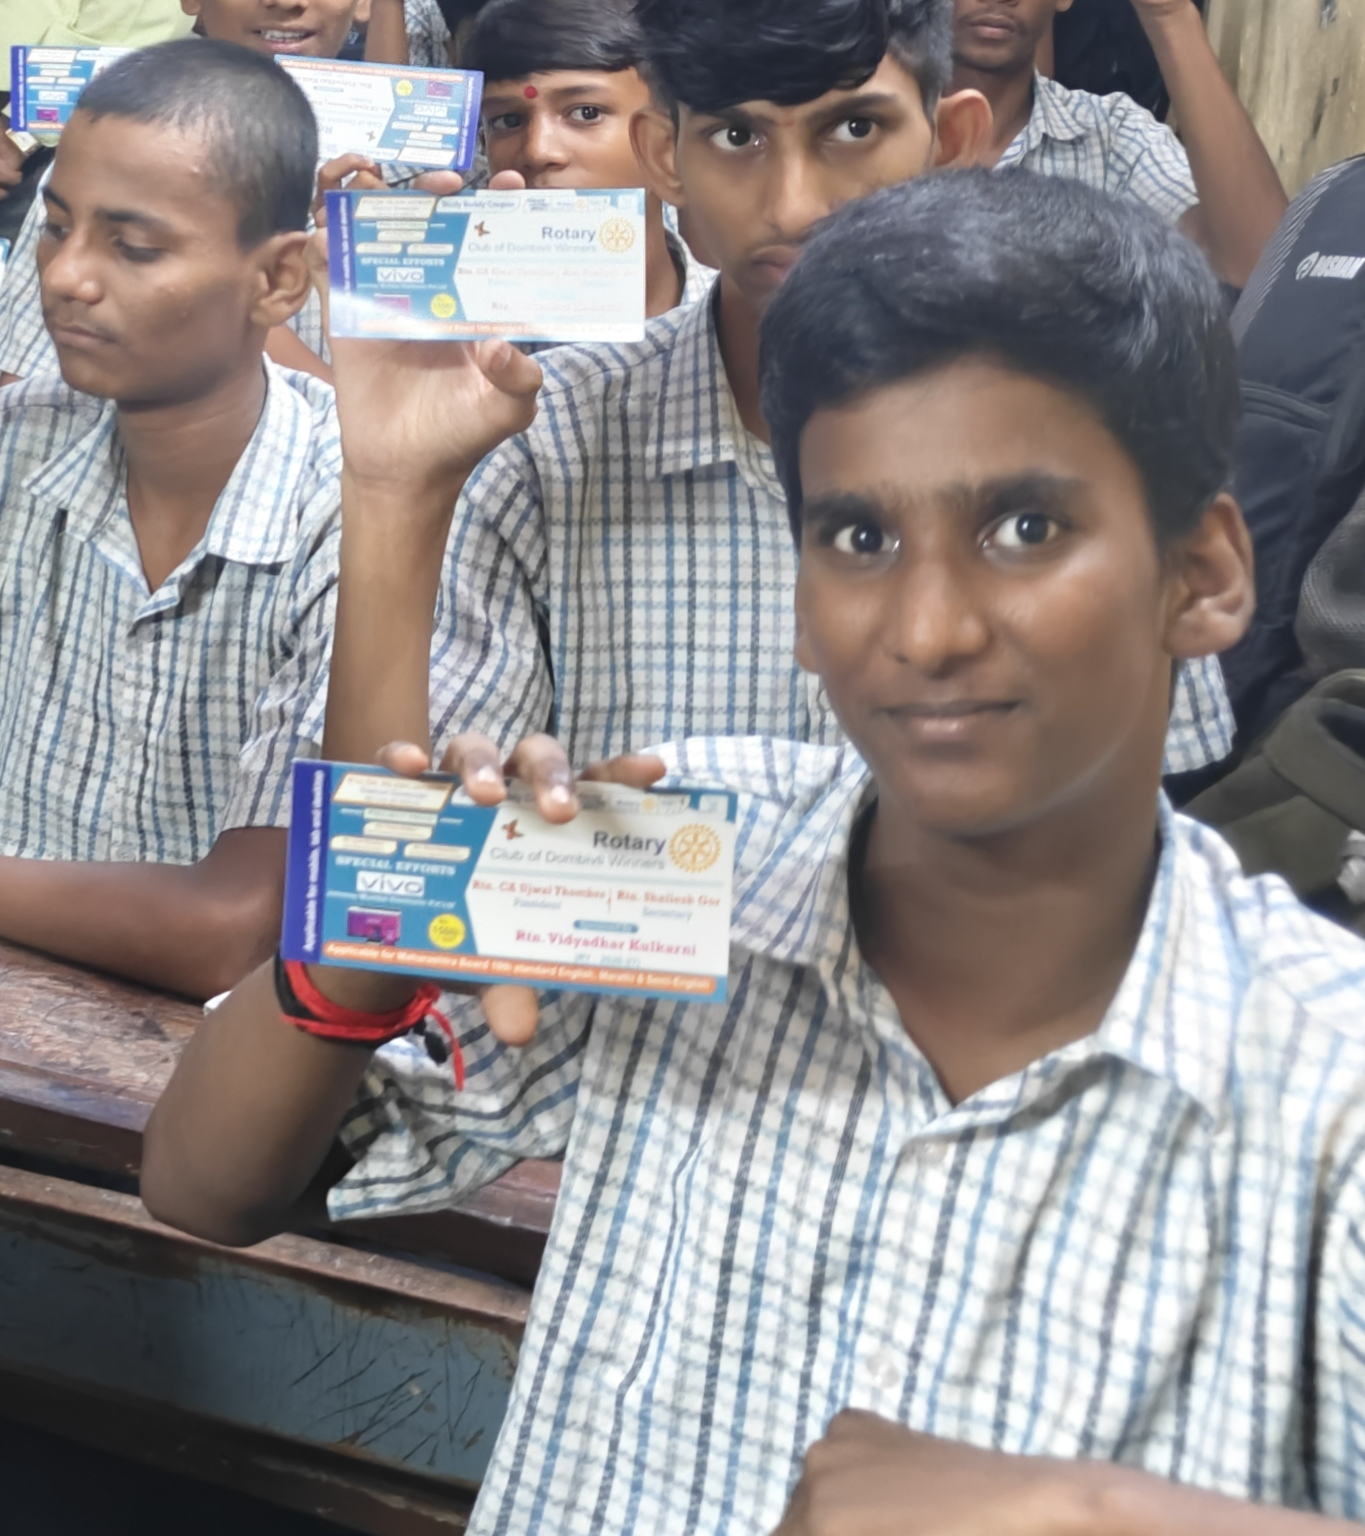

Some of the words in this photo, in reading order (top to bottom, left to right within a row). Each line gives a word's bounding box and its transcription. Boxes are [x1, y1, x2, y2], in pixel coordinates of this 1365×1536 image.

[541, 225, 595, 240] Rotary
[468, 242, 494, 252] Club
[496, 242, 506, 252] of
[552, 242, 595, 253] Winners
[379, 267, 423, 281] vivo
[311, 809, 322, 828] and
[310, 829, 322, 845] tab
[593, 829, 666, 855] Rotary
[335, 854, 392, 871] SPECIAL
[395, 859, 456, 877] EFFORTS
[490, 845, 527, 862] Club
[530, 848, 544, 863] of
[546, 849, 604, 868] Dombivli
[607, 853, 665, 872] Winners
[306, 883, 318, 899] for
[359, 872, 423, 895] vivo
[472, 879, 496, 891] Rtn.
[499, 880, 518, 893] CA
[617, 890, 641, 903] Rtn.
[697, 895, 721, 908] Gor
[303, 899, 318, 951] Applicable
[515, 930, 547, 944] Rtn.
[549, 932, 625, 954] Vidyadhar
[628, 938, 697, 957] Kulkarni
[326, 944, 380, 961] Applicable
[382, 949, 397, 961] for
[398, 950, 457, 967] Maharashtra
[459, 956, 489, 970] Board
